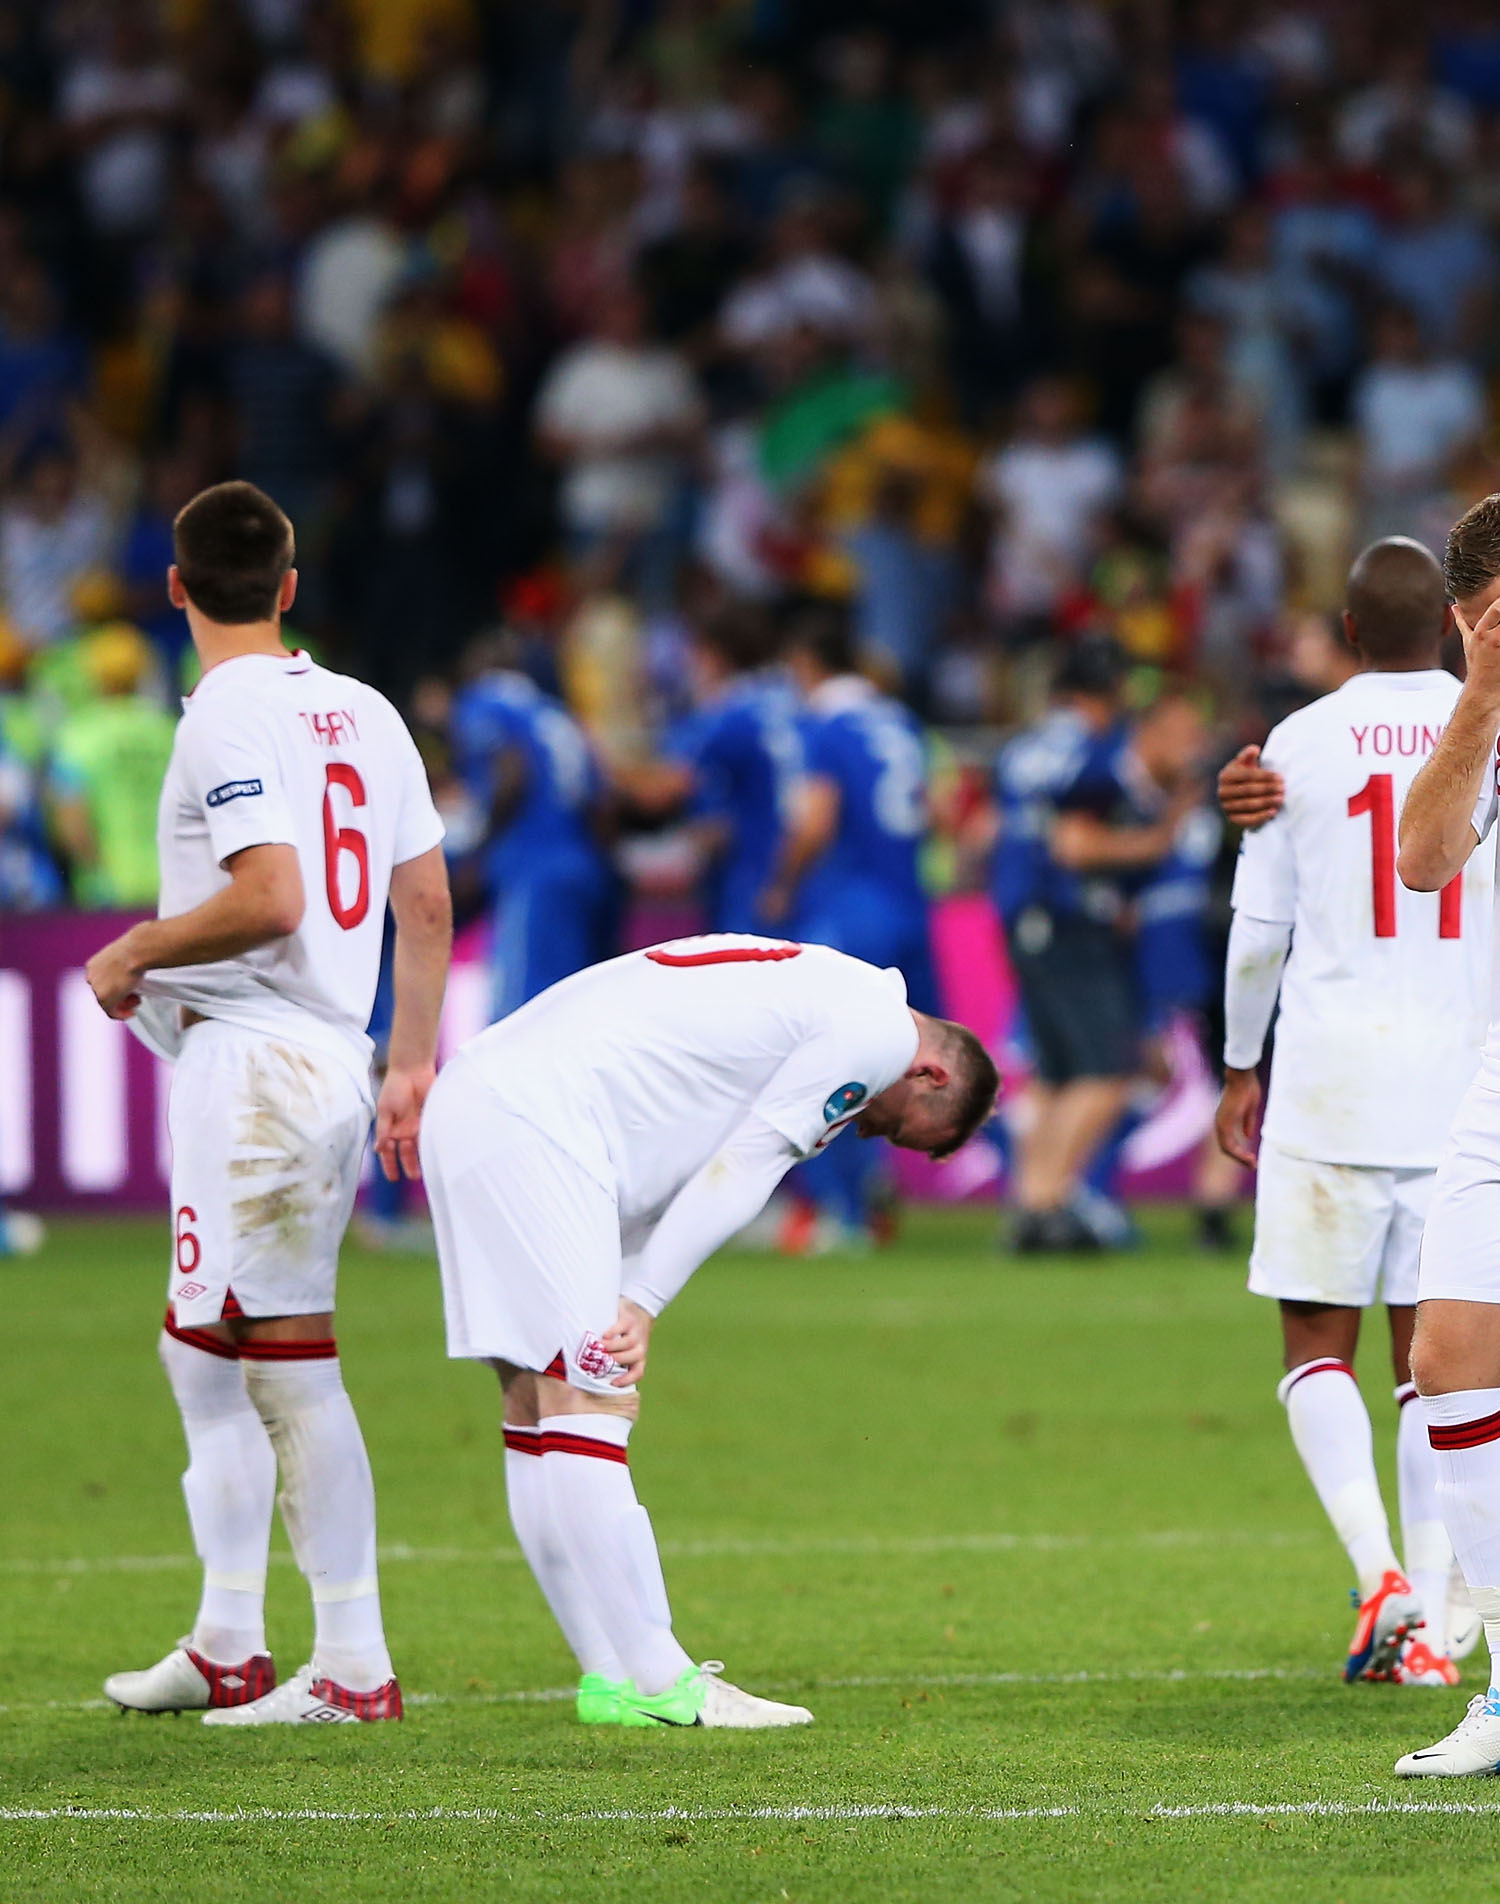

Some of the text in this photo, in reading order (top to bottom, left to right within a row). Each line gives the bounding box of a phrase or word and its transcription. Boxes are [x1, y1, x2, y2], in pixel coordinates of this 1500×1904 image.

[1350, 724, 1442, 756] YOUN
[322, 762, 371, 931] 6
[177, 1206, 200, 1274] 6
